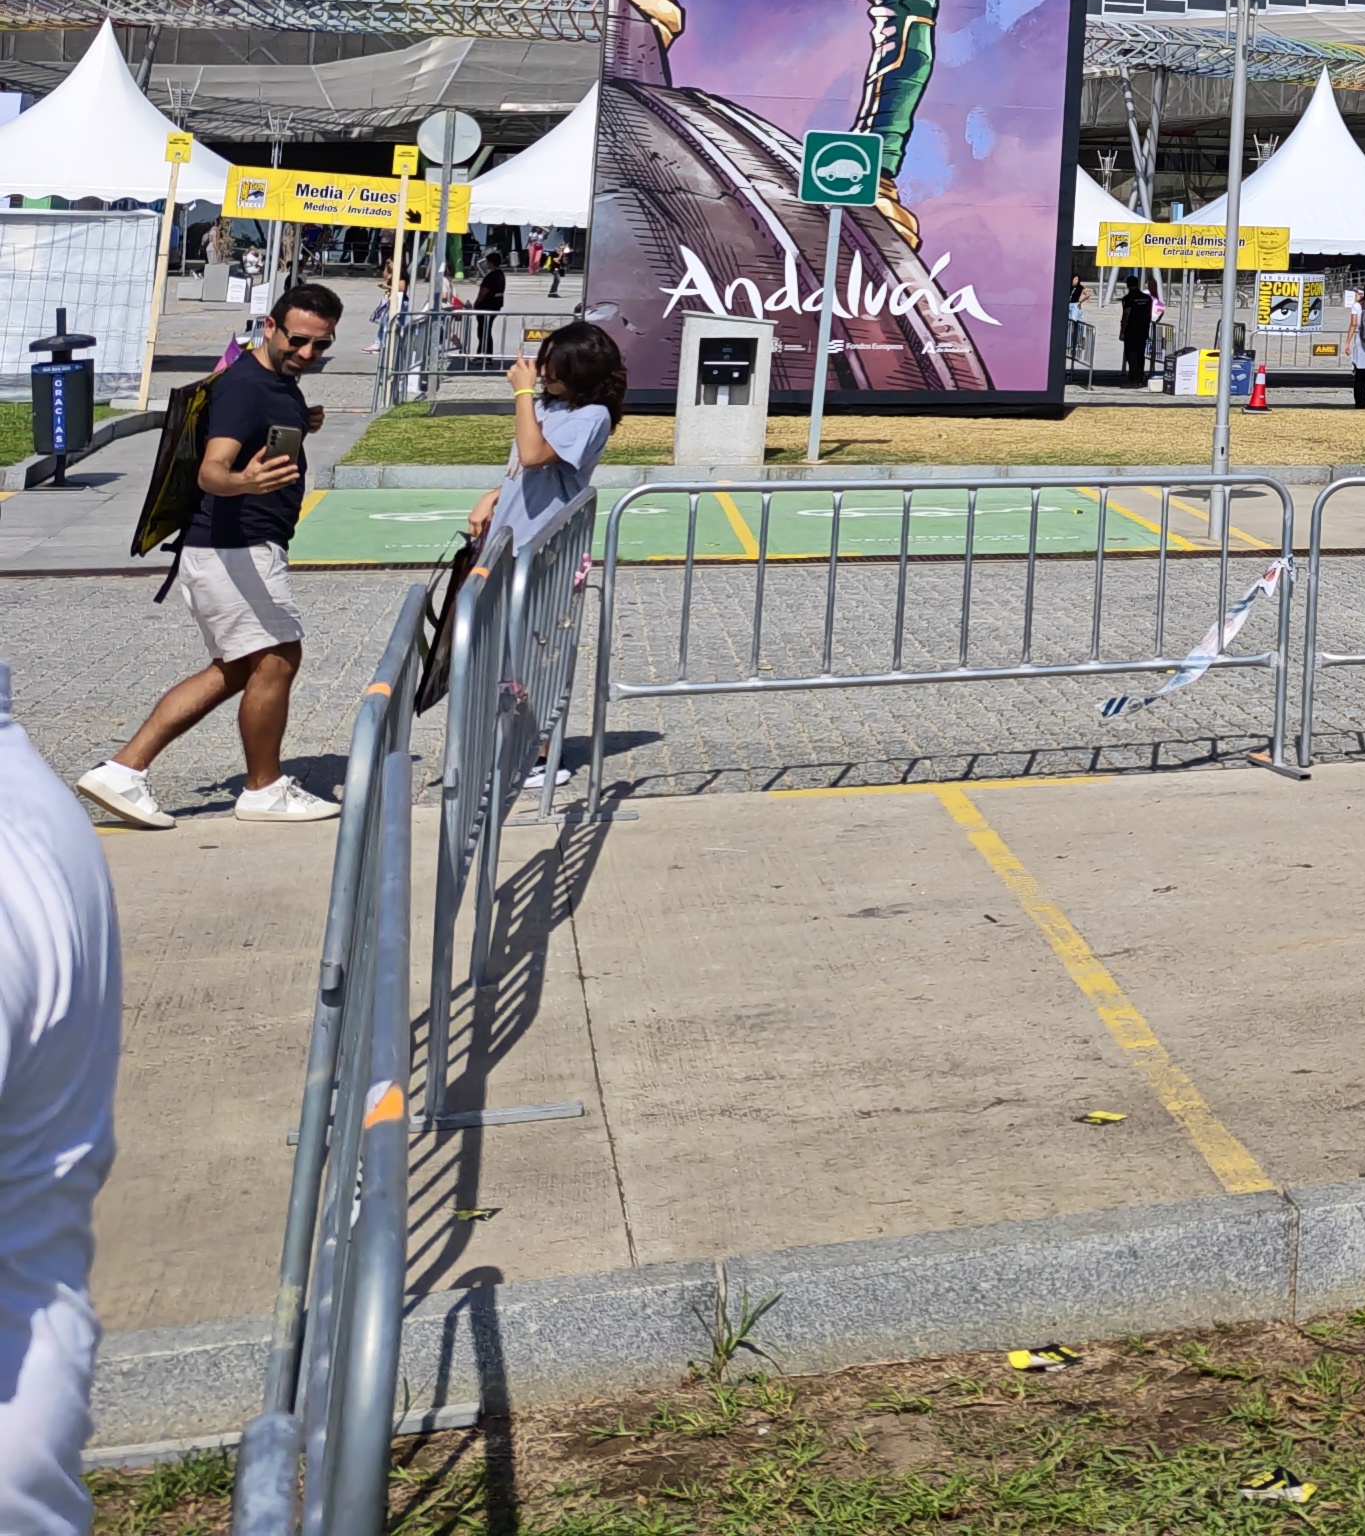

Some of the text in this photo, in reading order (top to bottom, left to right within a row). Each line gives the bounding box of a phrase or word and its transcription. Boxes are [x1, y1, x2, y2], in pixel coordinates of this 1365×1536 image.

[295, 183, 343, 201] Media
[303, 201, 338, 213] Medios
[347, 204, 393, 217] Invitados
[1144, 233, 1246, 247] General Admisn
[658, 244, 1003, 327] Andalucía
[1272, 282, 1300, 297] CON
[1258, 281, 1273, 325] COMIC
[54, 379, 64, 443] GRACIAS
